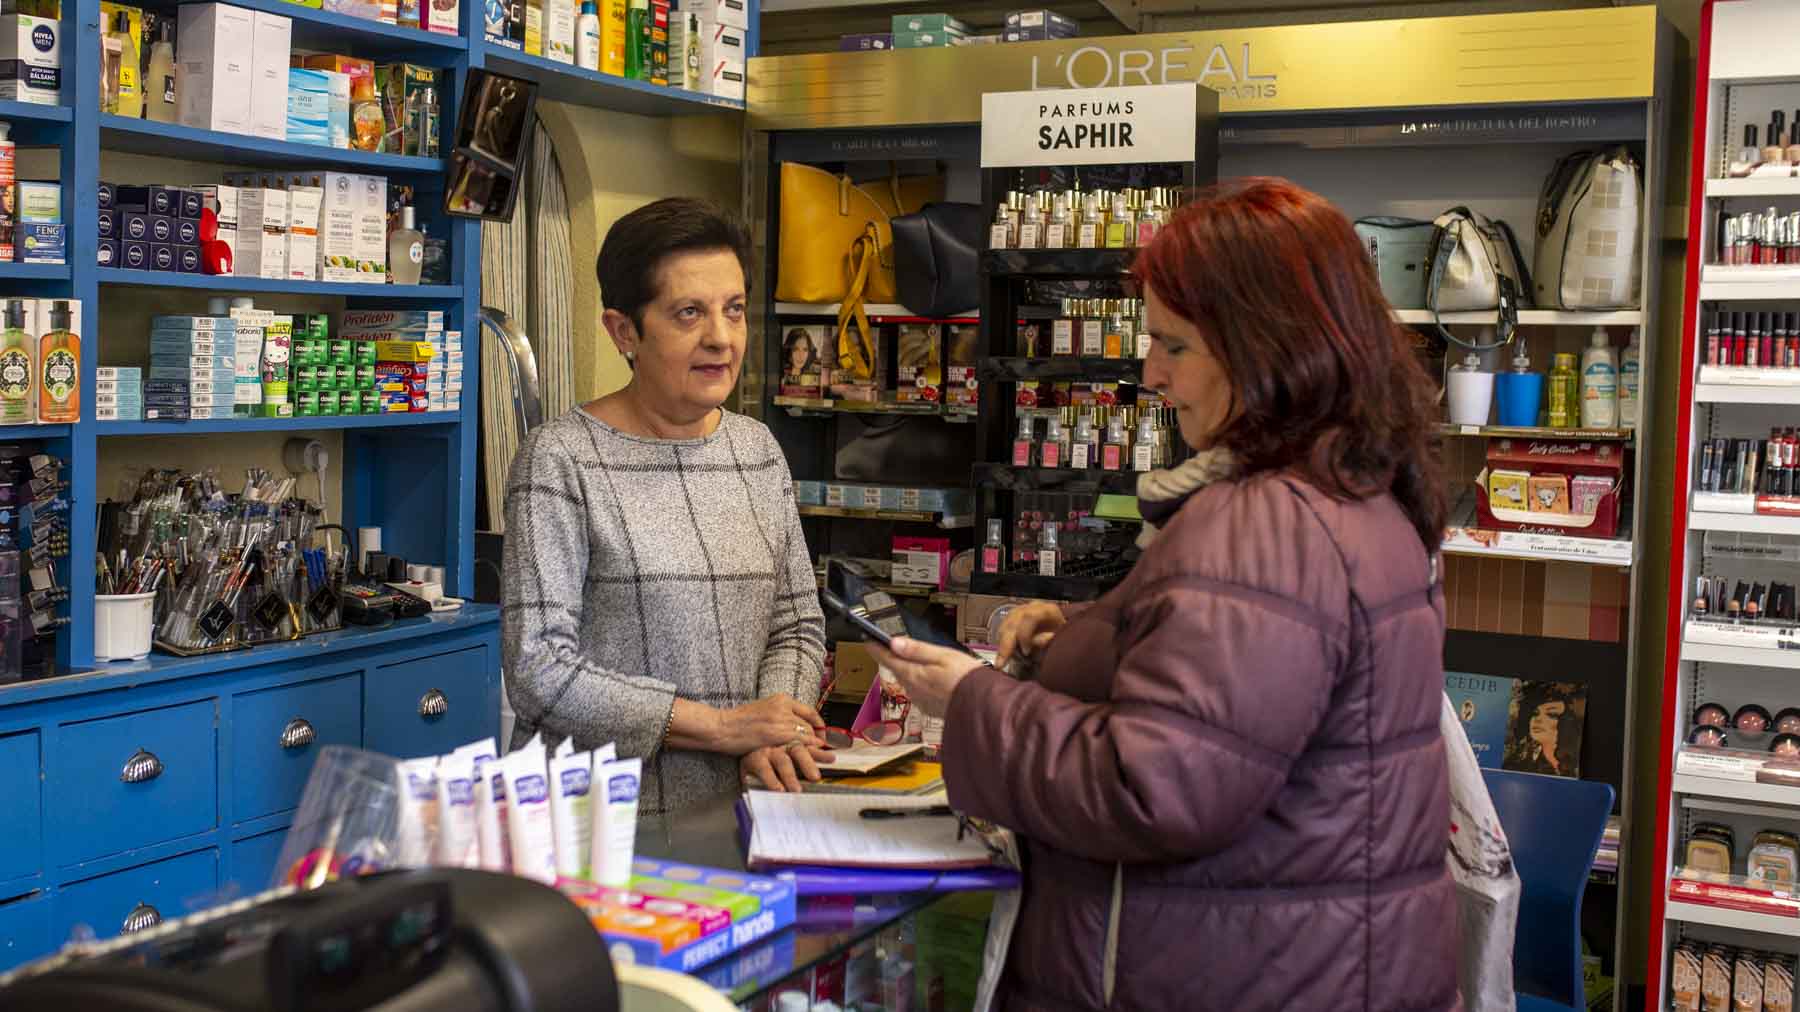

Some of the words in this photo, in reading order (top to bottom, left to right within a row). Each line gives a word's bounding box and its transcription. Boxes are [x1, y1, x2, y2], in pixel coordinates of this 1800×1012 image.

[34, 32, 53, 41] NIVEA
[35, 38, 52, 46] MEN
[1216, 84, 1277, 99] PARIS
[1039, 101, 1134, 118] PARFUMS
[1401, 123, 1416, 134] LA
[1518, 118, 1541, 129] DEL
[1545, 115, 1598, 129] ROSTRO
[1038, 122, 1134, 150] SAPHIR
[36, 225, 60, 235] FENG
[683, 930, 729, 970] PERFECT
[731, 909, 775, 947] hands
